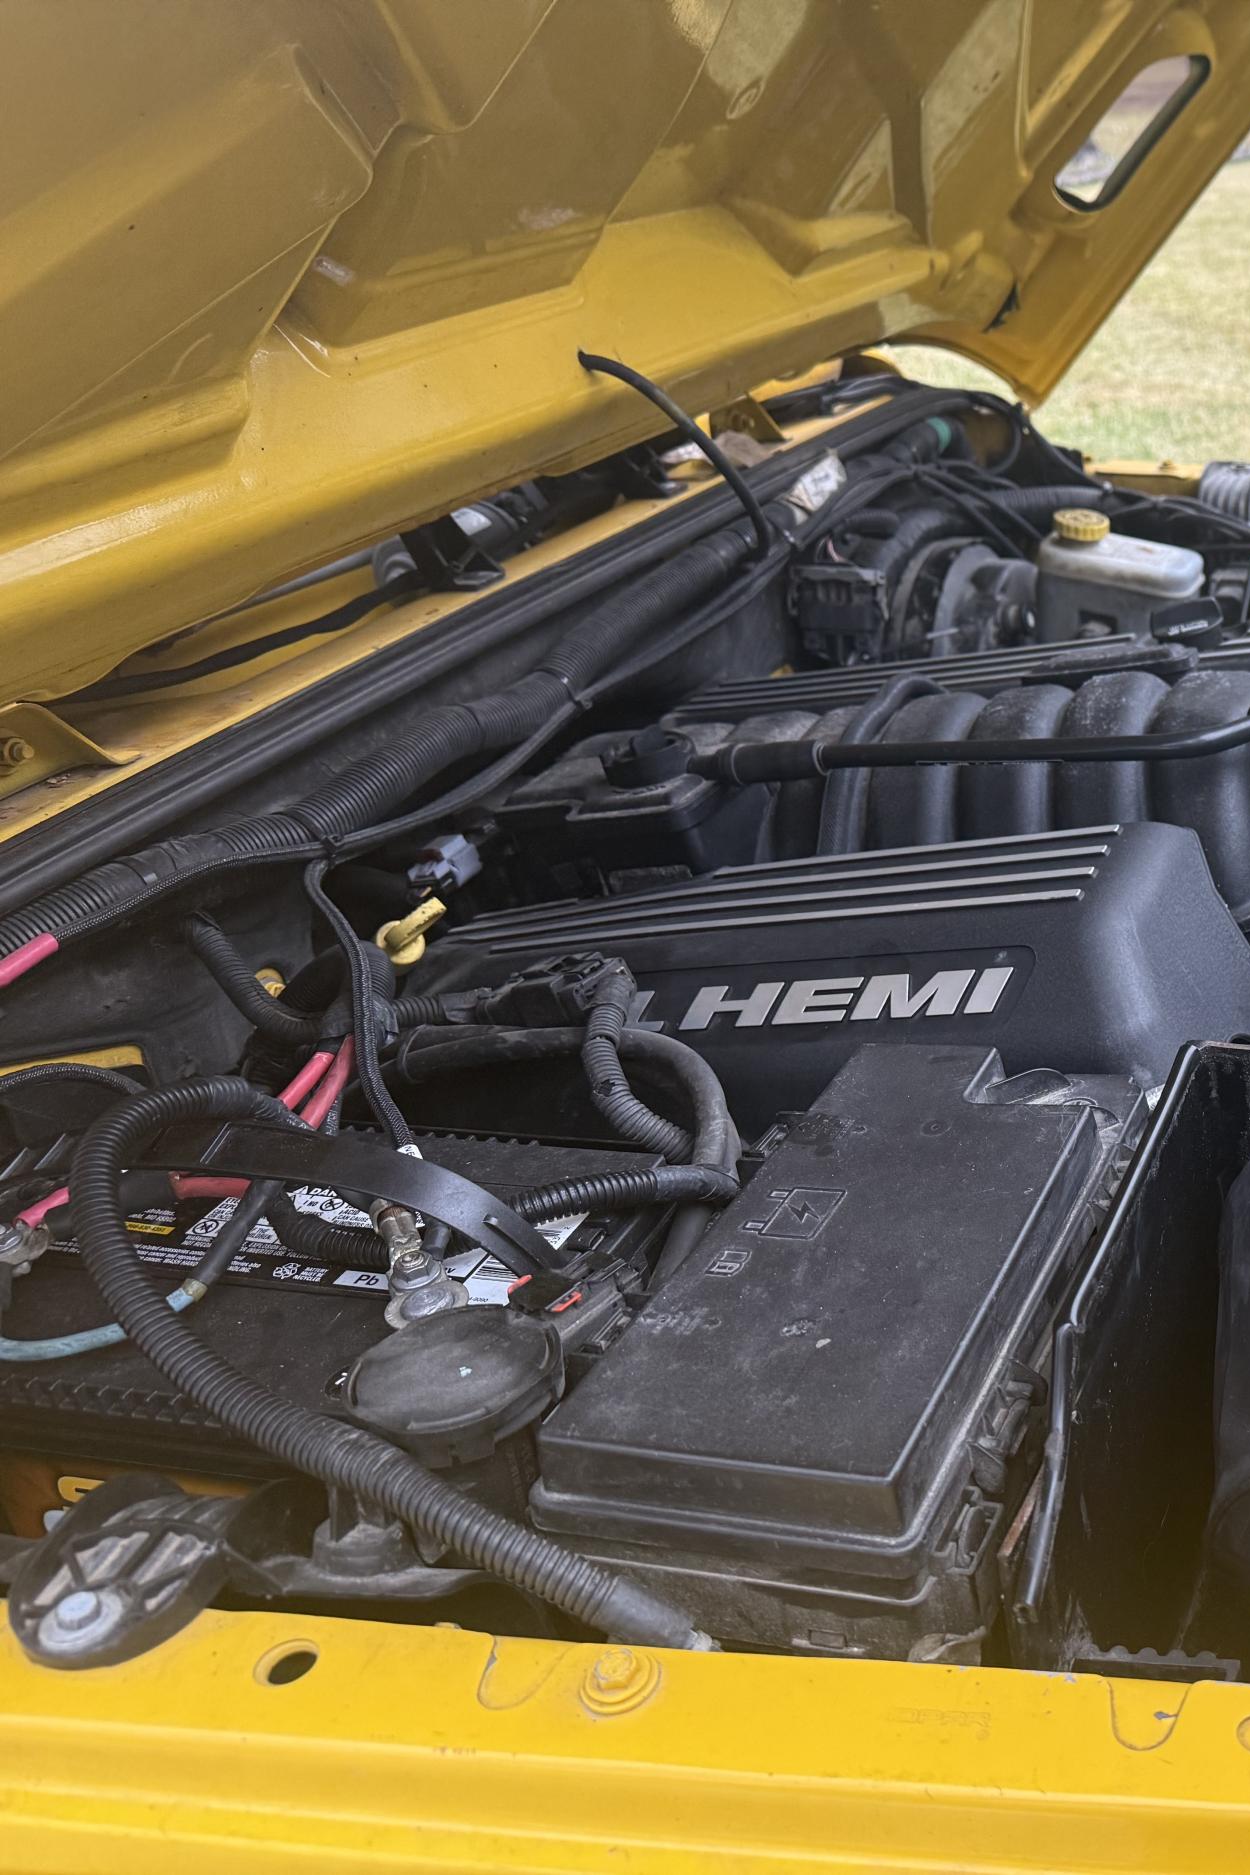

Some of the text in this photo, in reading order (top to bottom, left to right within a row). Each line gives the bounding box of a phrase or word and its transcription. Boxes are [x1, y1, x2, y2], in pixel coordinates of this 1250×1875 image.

[678, 966, 1015, 1031] HEMI
[310, 1187, 337, 1197] DAN
[305, 1266, 329, 1274] BATTERY
[292, 1275, 322, 1283] RECYCLED
[353, 1274, 380, 1287] Pb
